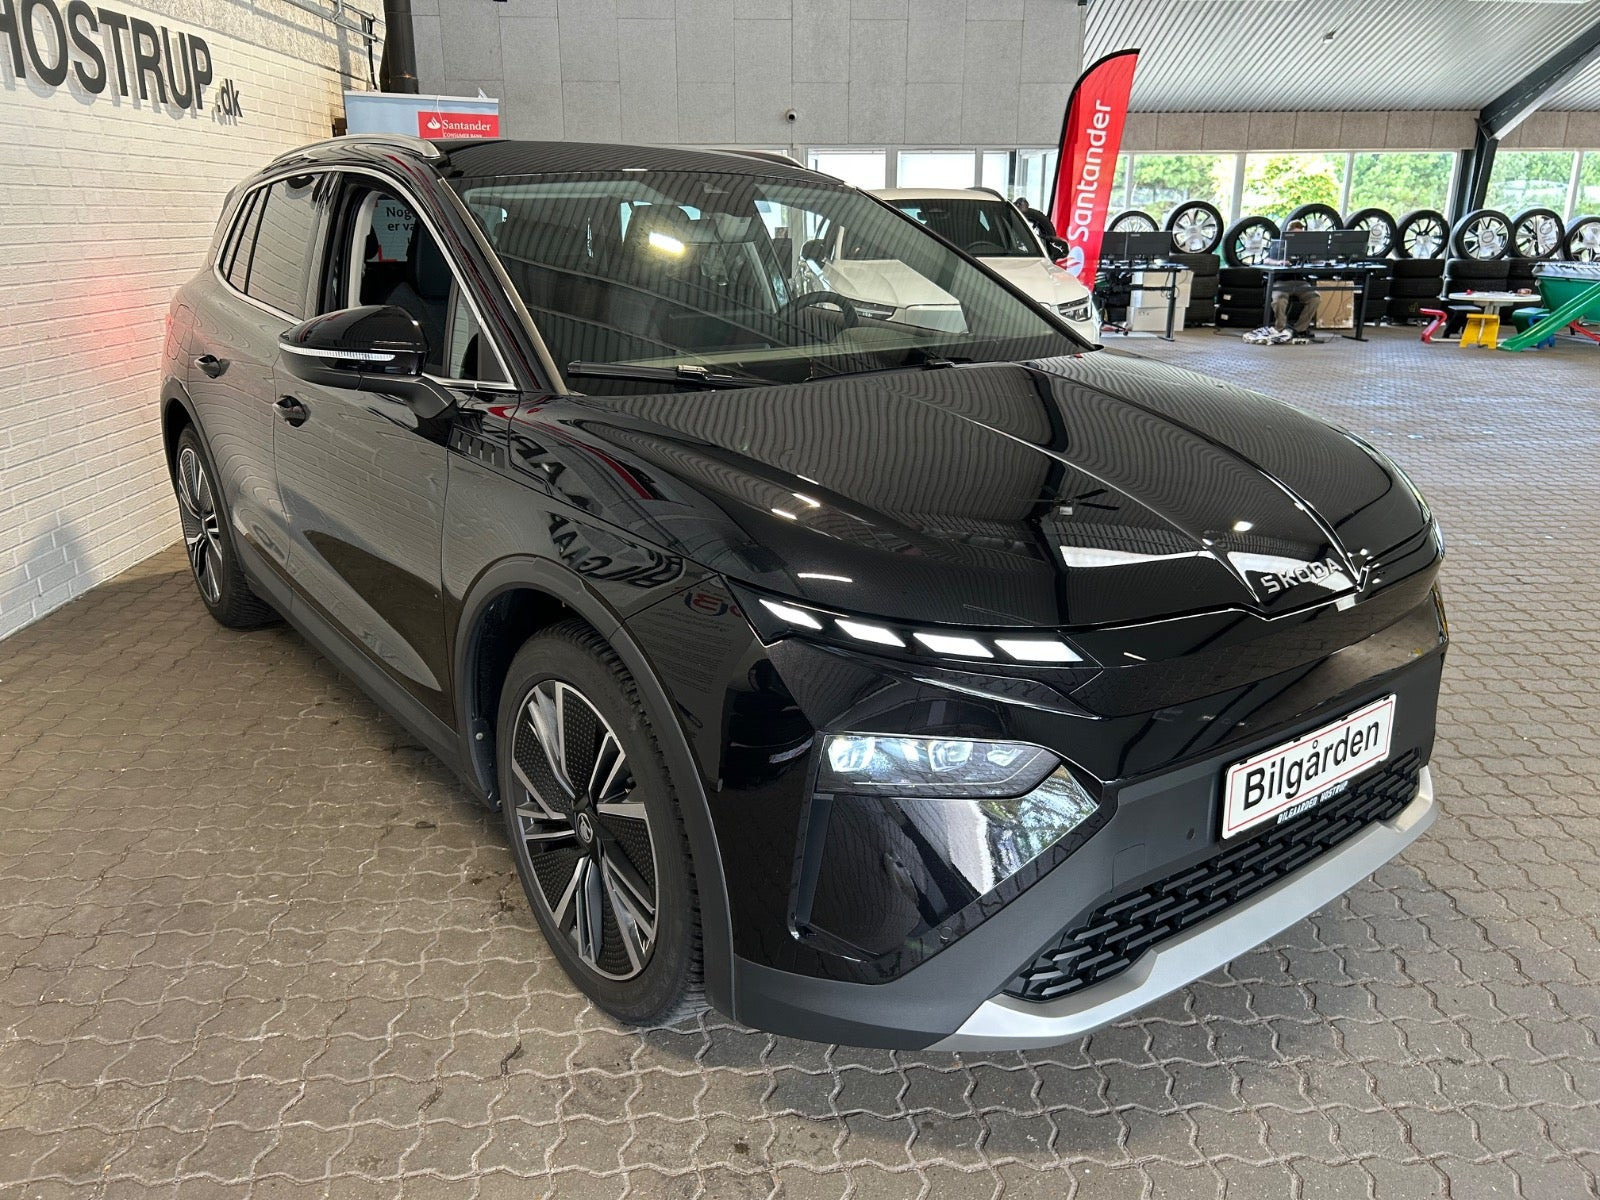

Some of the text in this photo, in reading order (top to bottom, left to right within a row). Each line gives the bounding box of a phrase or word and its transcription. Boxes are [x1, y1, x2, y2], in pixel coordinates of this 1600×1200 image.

[442, 119, 492, 132] Santander
[1066, 99, 1112, 243] Santander
[386, 206, 416, 220] Nog
[388, 223, 417, 231] er va
[1243, 721, 1380, 811] Bilgården
